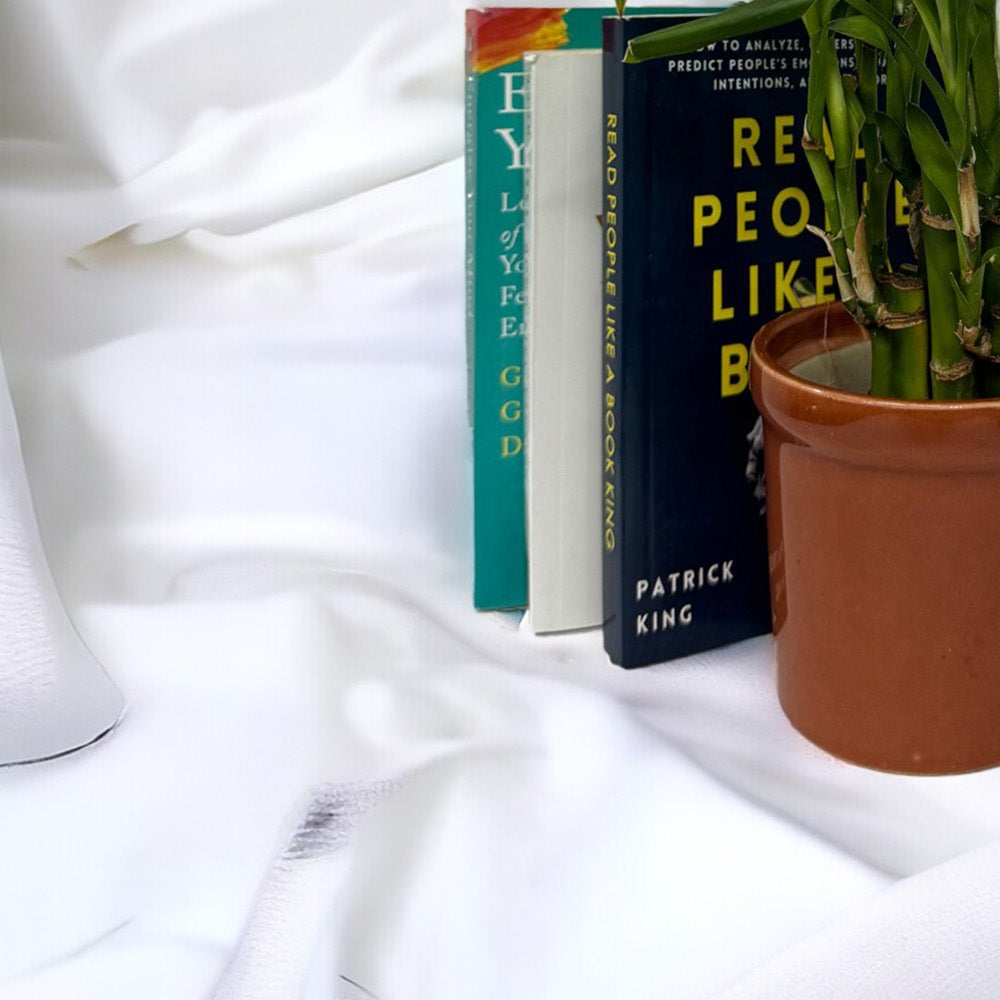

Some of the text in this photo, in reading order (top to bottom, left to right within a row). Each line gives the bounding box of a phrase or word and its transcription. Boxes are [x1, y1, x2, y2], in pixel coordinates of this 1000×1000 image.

[722, 39, 740, 52] TO
[745, 38, 804, 52] ANALYZE,
[668, 59, 723, 73] PREDICT
[729, 57, 788, 71] PEOPLE'S
[713, 76, 794, 91] INTENTIONS,
[604, 113, 618, 551] READ PEOPLE LIKE A BOOK KING
[636, 560, 734, 602] PATRICK
[636, 603, 692, 636] KING
